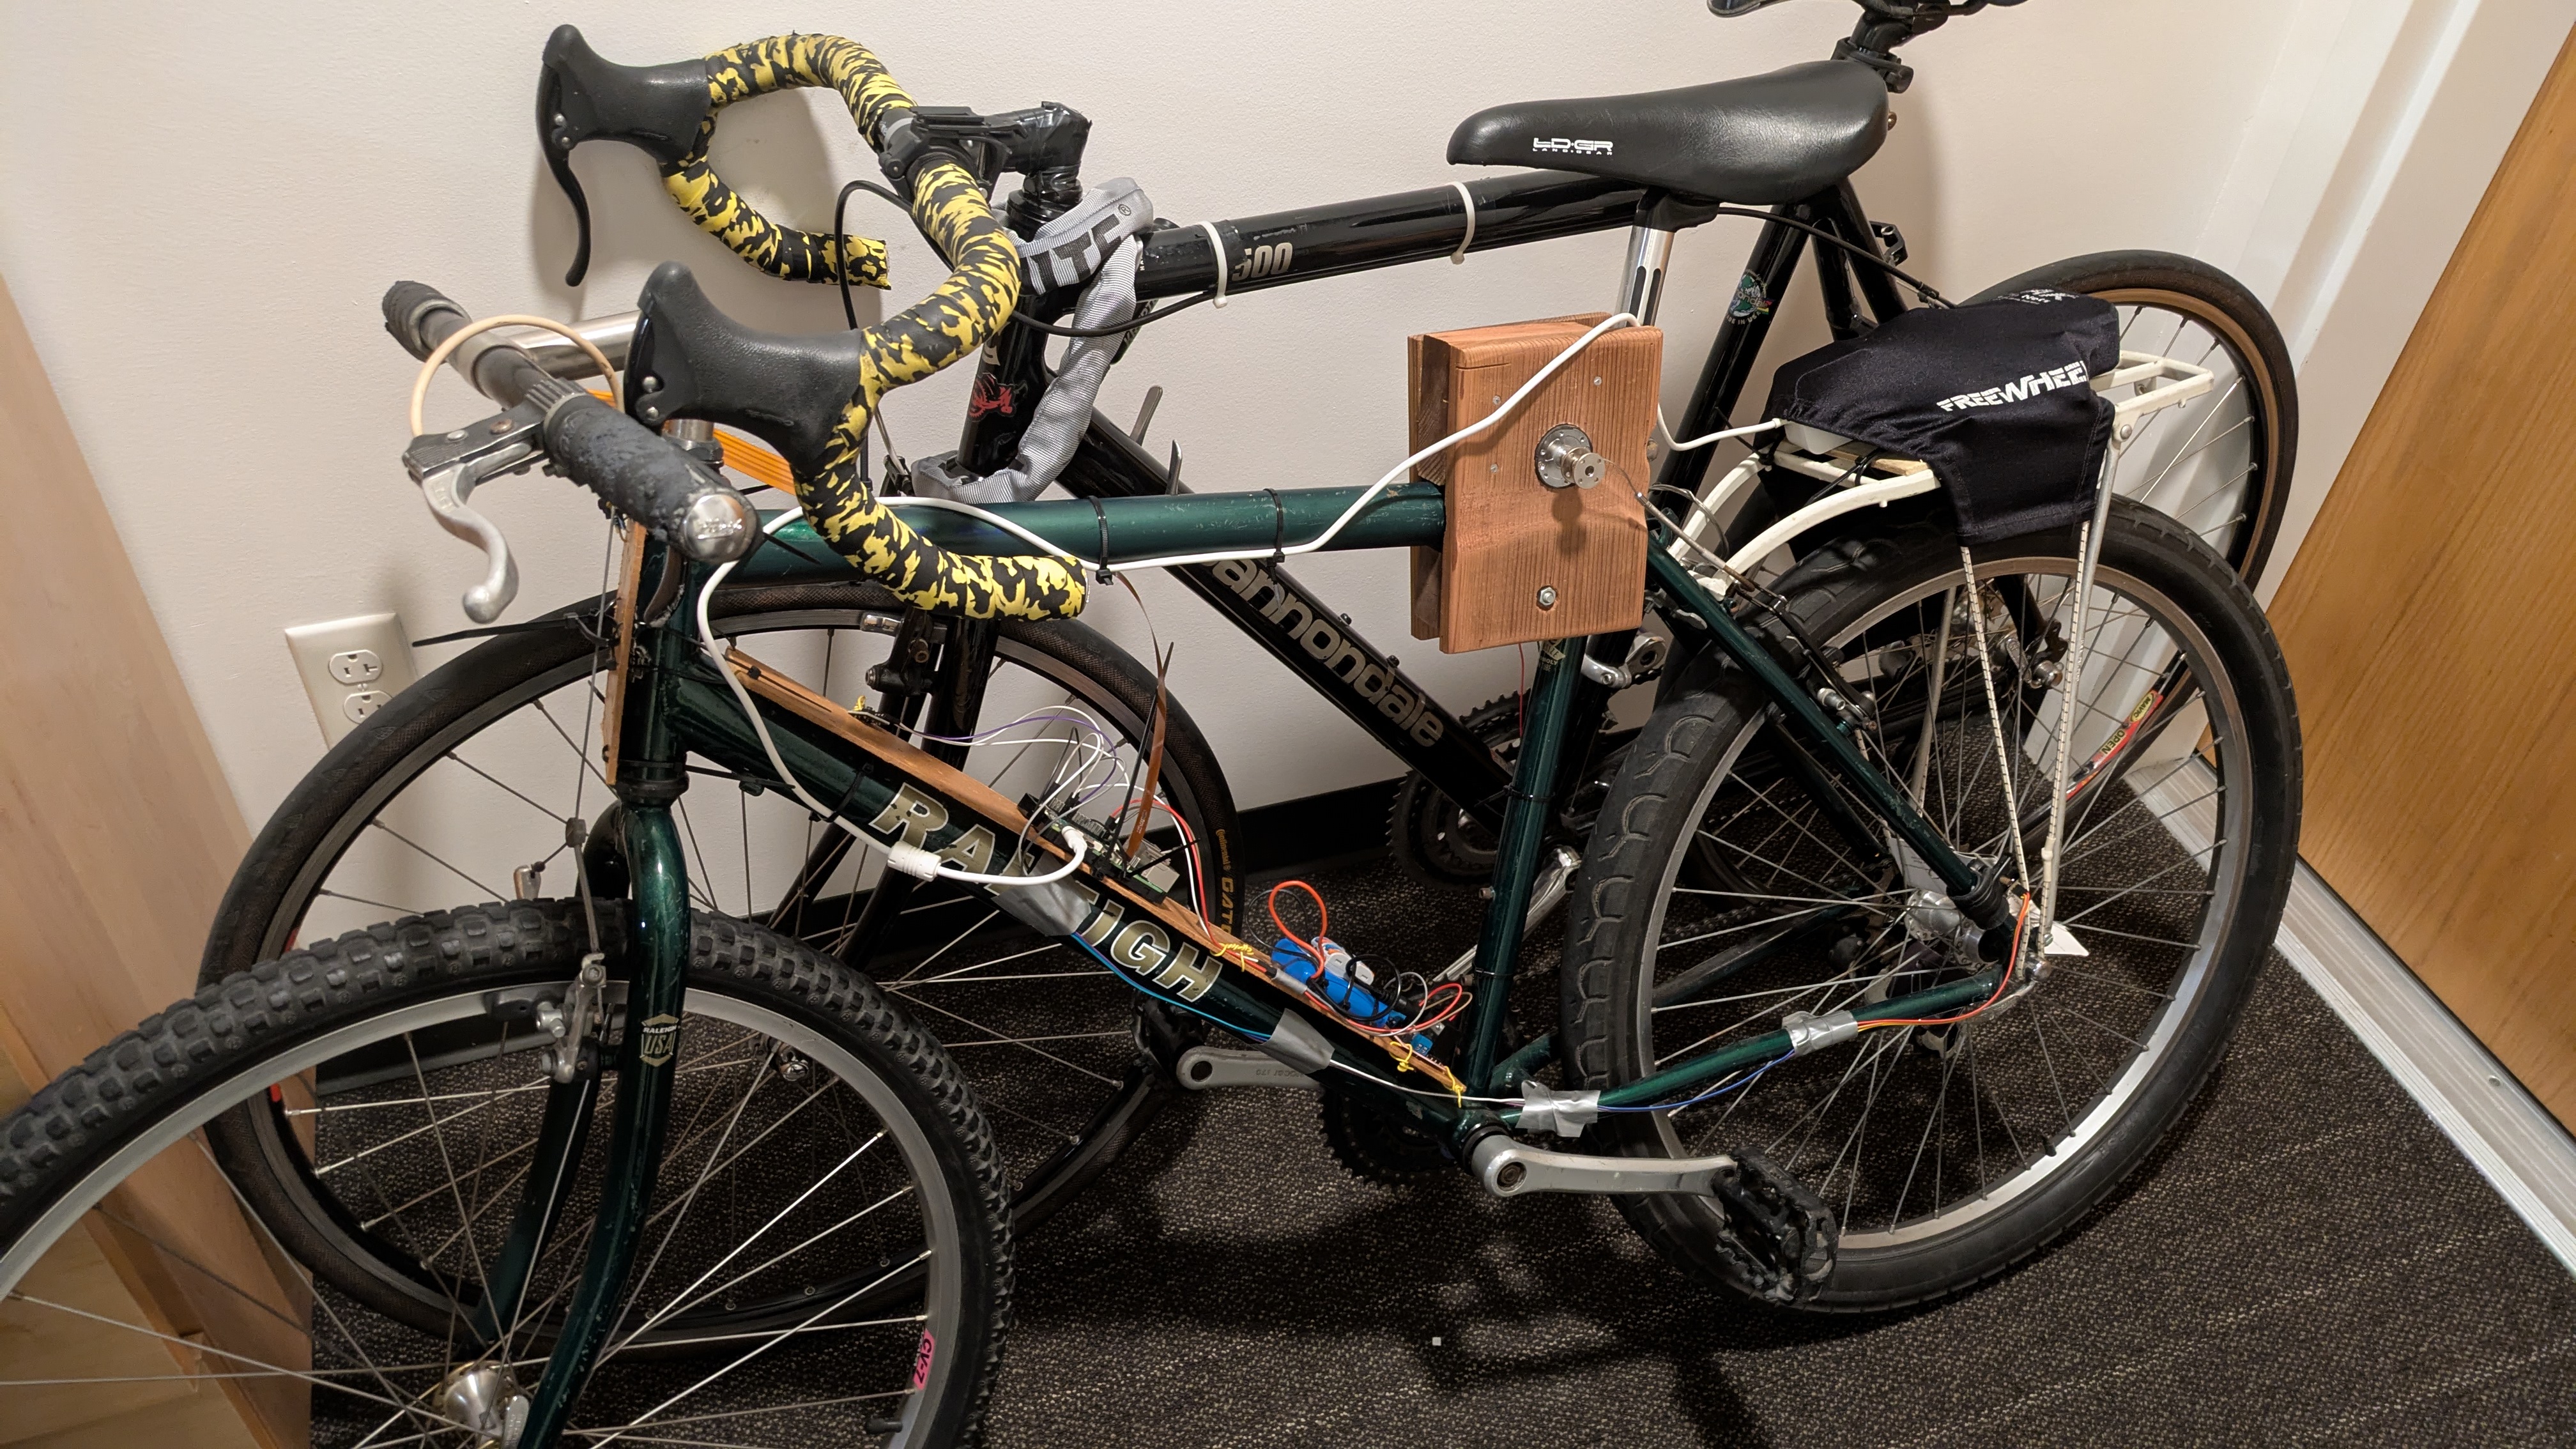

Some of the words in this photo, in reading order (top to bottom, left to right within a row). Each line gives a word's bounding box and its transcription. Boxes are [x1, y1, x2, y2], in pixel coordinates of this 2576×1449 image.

[1200, 558, 1445, 747] annondale
[2133, 696, 2152, 718] MAVIC
[2101, 730, 2126, 755] OPEN
[643, 1025, 677, 1034] RALEIGH
[644, 1032, 673, 1054] USA
[916, 1338, 932, 1384] CV-7
